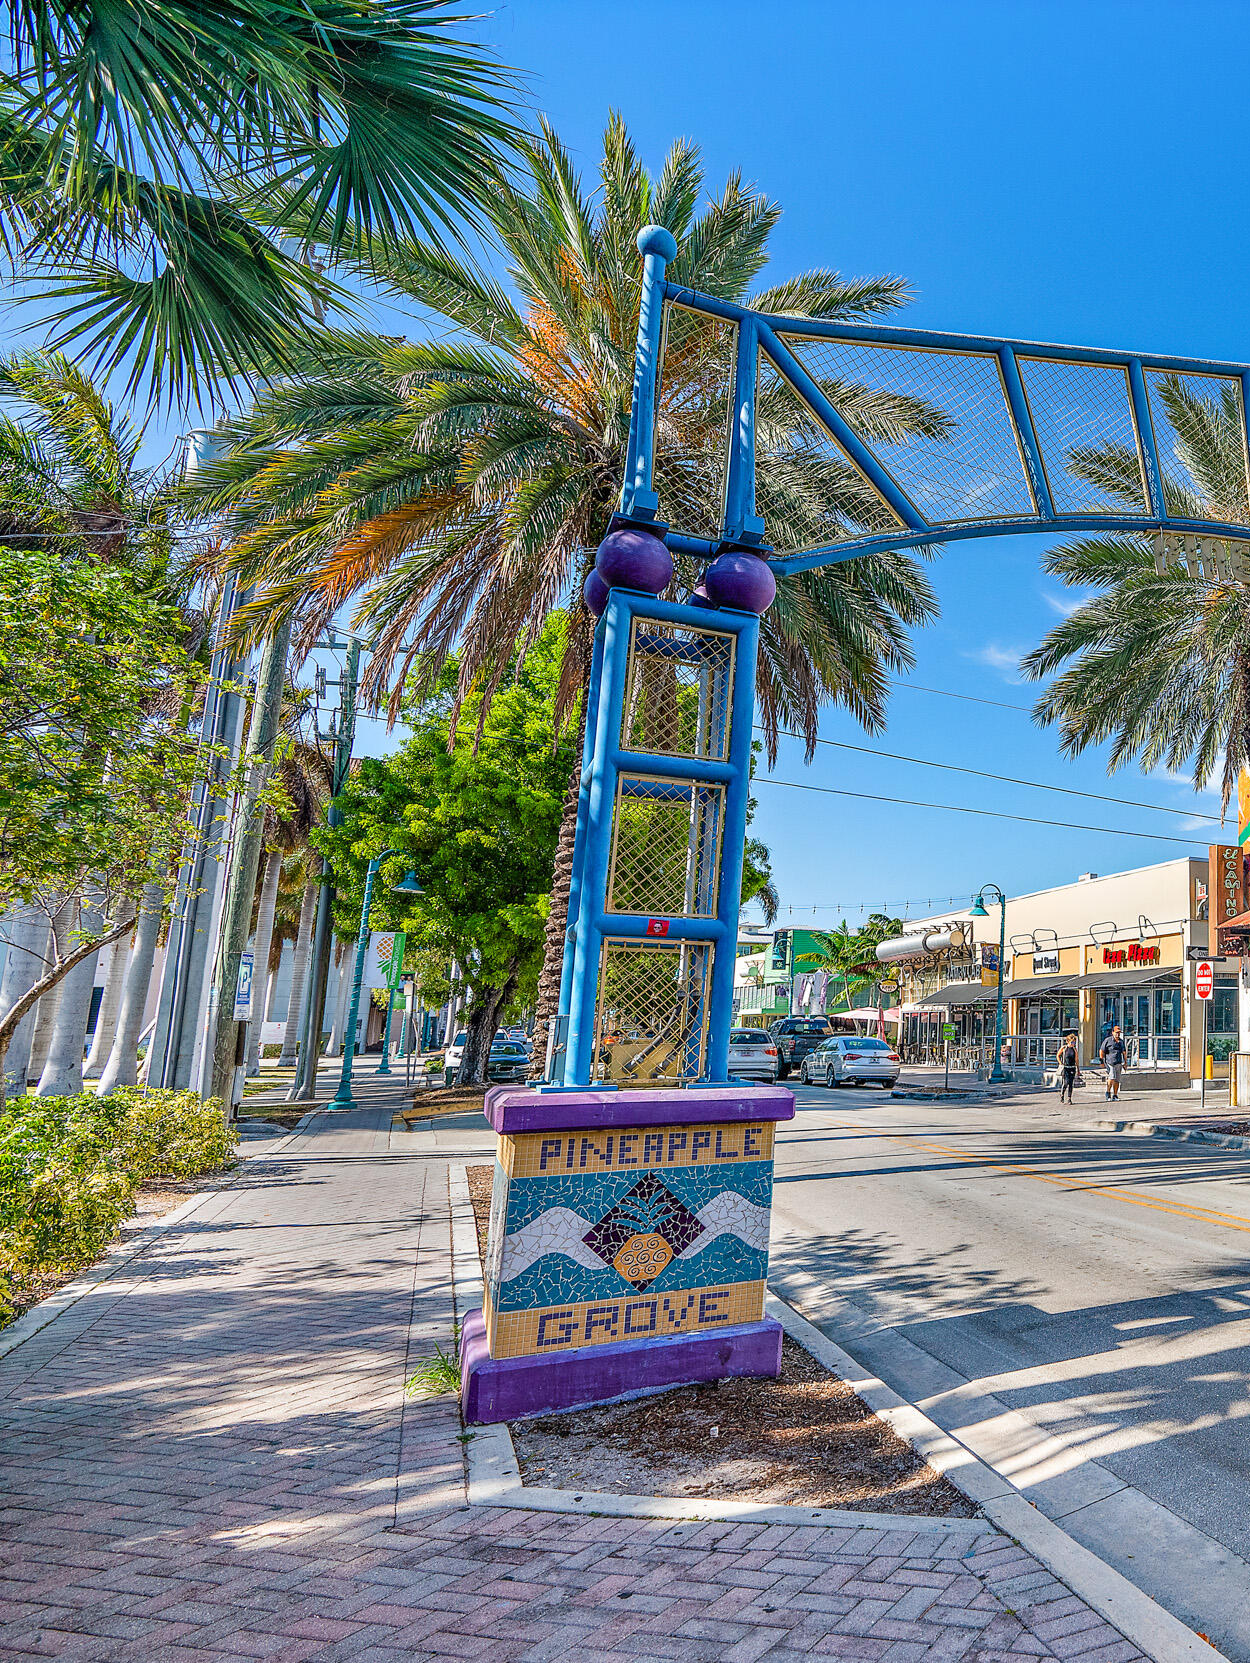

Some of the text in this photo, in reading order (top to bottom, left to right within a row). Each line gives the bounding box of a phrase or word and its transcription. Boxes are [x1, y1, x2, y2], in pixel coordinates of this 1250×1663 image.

[1224, 861, 1241, 917] CAMINO
[540, 1128, 762, 1170] PINEAPPLE
[537, 1291, 729, 1347] GROVE
